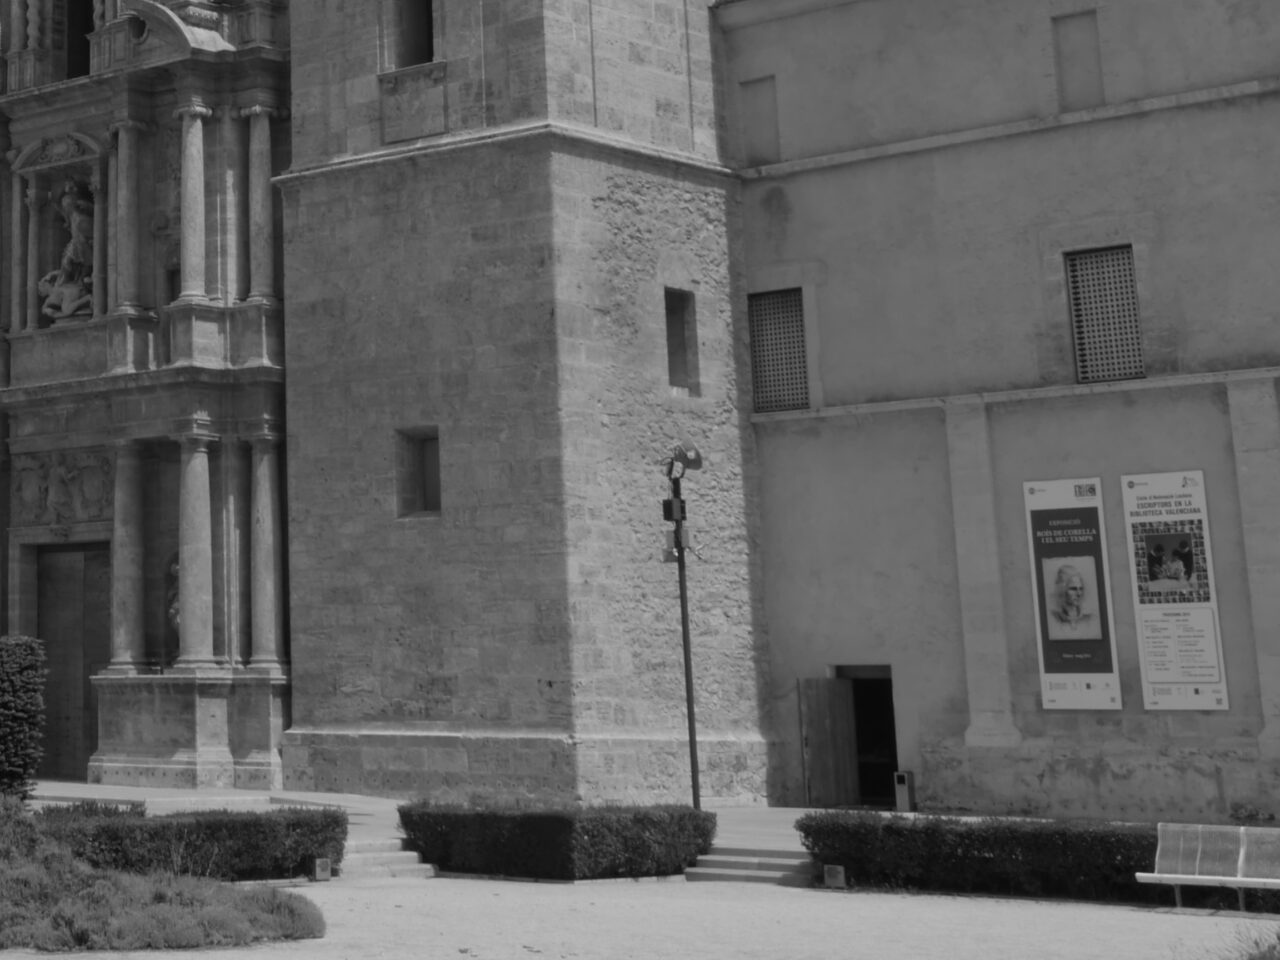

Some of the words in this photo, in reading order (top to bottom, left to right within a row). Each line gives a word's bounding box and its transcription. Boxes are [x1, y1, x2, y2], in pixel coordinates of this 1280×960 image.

[1137, 501, 1172, 509] ESCRIPTORS
[1053, 529, 1063, 537] DE
[1064, 527, 1097, 536] CORELLA
